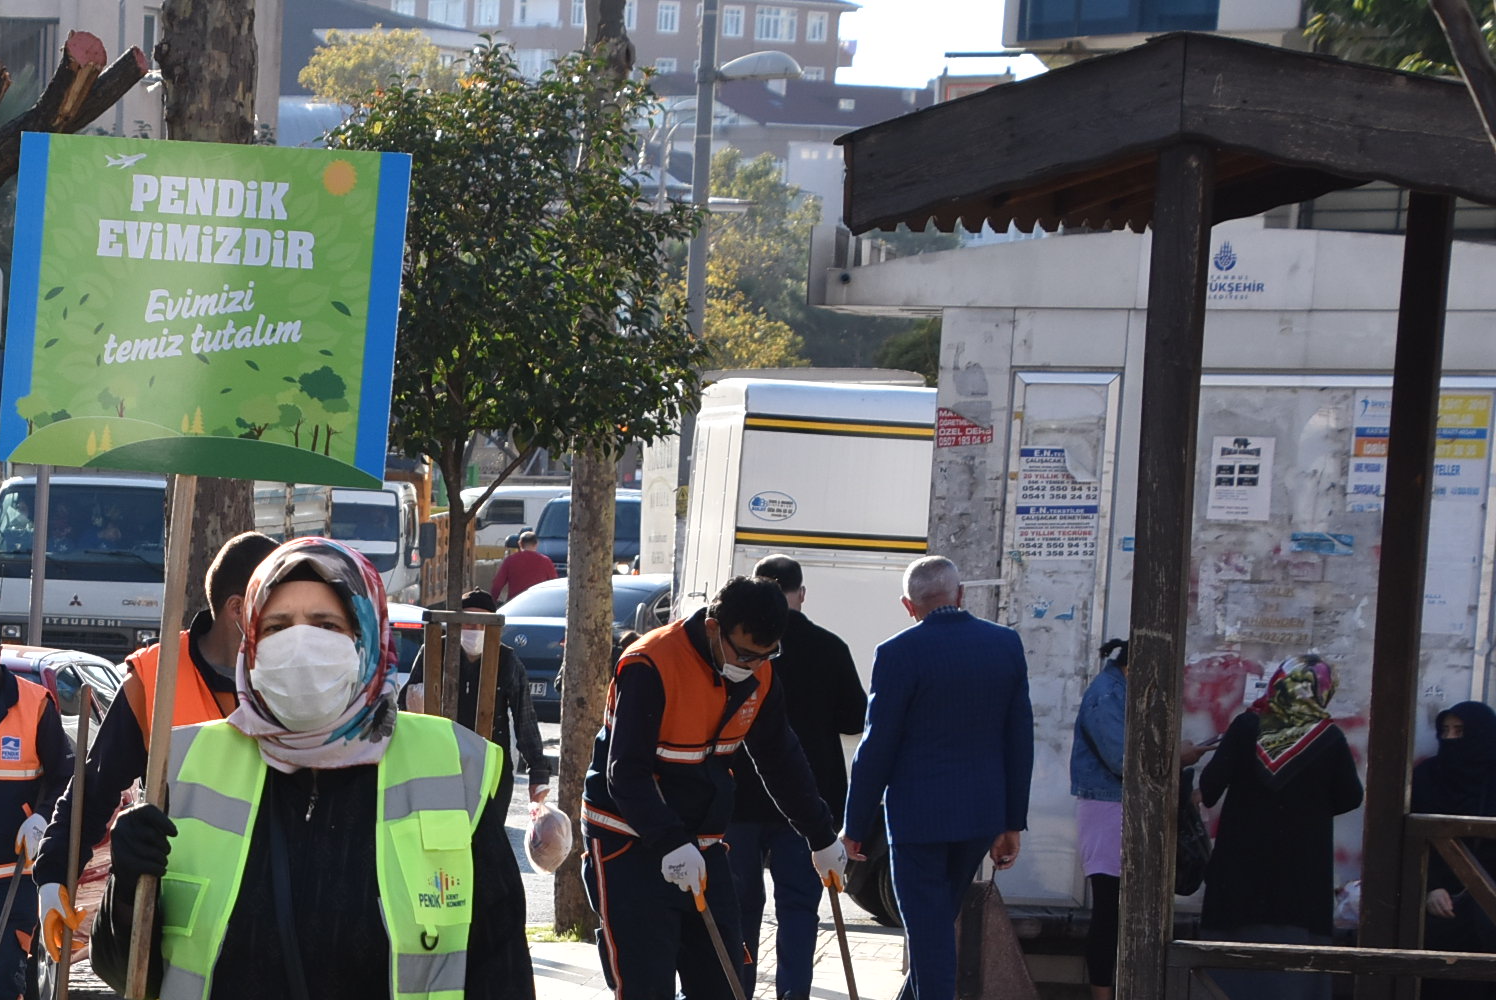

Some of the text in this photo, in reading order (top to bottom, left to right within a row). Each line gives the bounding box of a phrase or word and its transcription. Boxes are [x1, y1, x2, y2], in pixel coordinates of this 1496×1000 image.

[1208, 279, 1264, 294] ÜKŞEHİR
[144, 281, 255, 323] Evimizi
[104, 314, 302, 365] temiz tutalım
[1434, 464, 1460, 476] TELLER
[45, 617, 122, 627] ITSUBISHI
